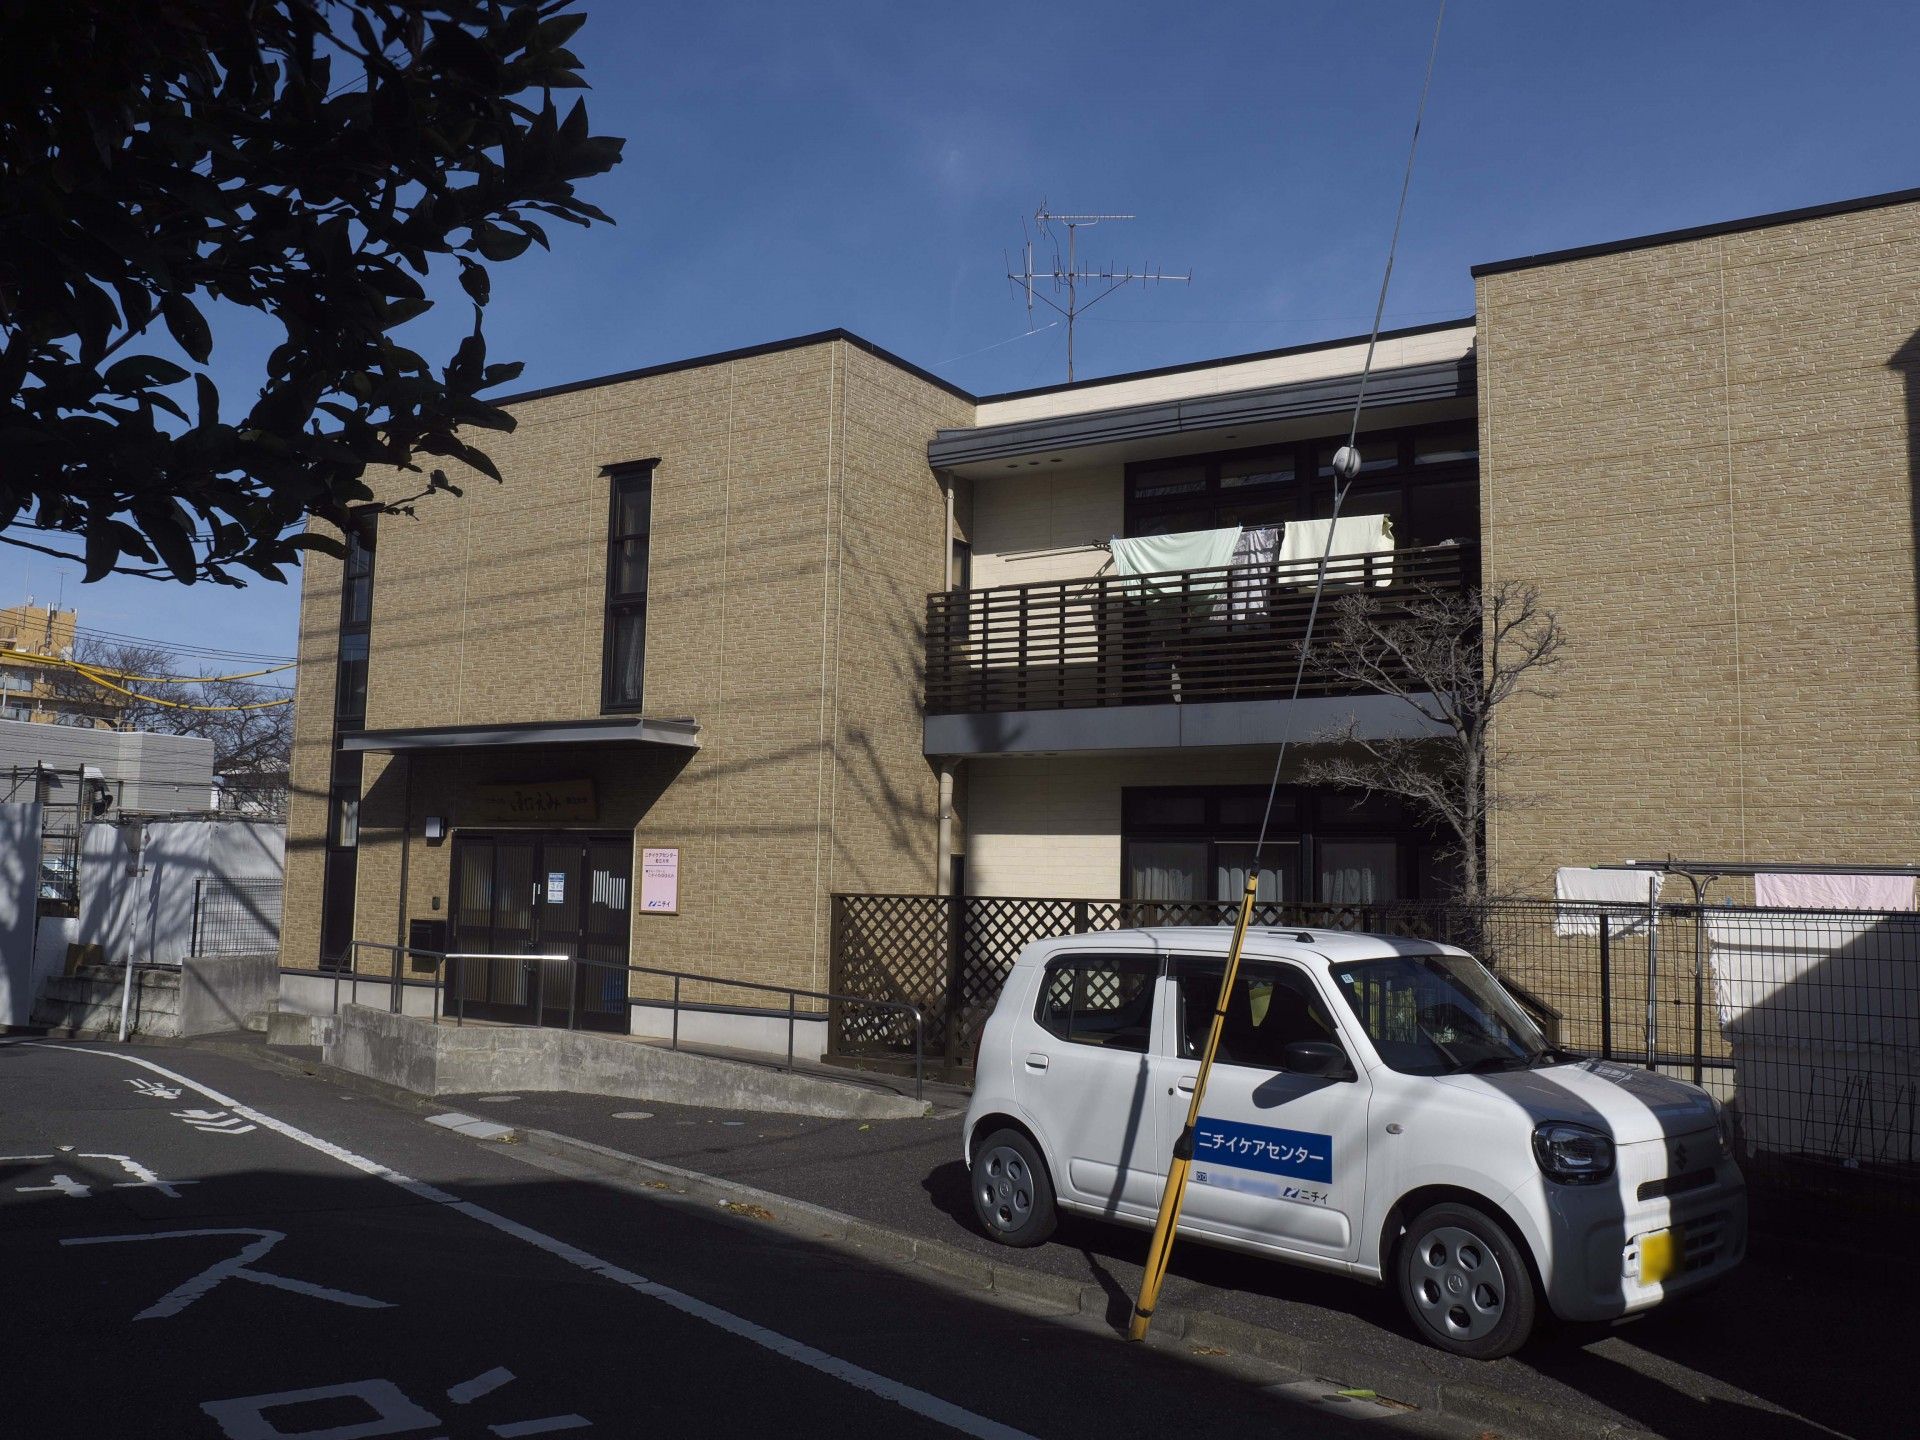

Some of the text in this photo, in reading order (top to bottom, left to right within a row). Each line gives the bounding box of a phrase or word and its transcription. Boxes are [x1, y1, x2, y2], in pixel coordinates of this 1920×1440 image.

[1199, 1131, 1324, 1164] ニチイケアセンター
[1300, 1189, 1329, 1205] ニチイ
